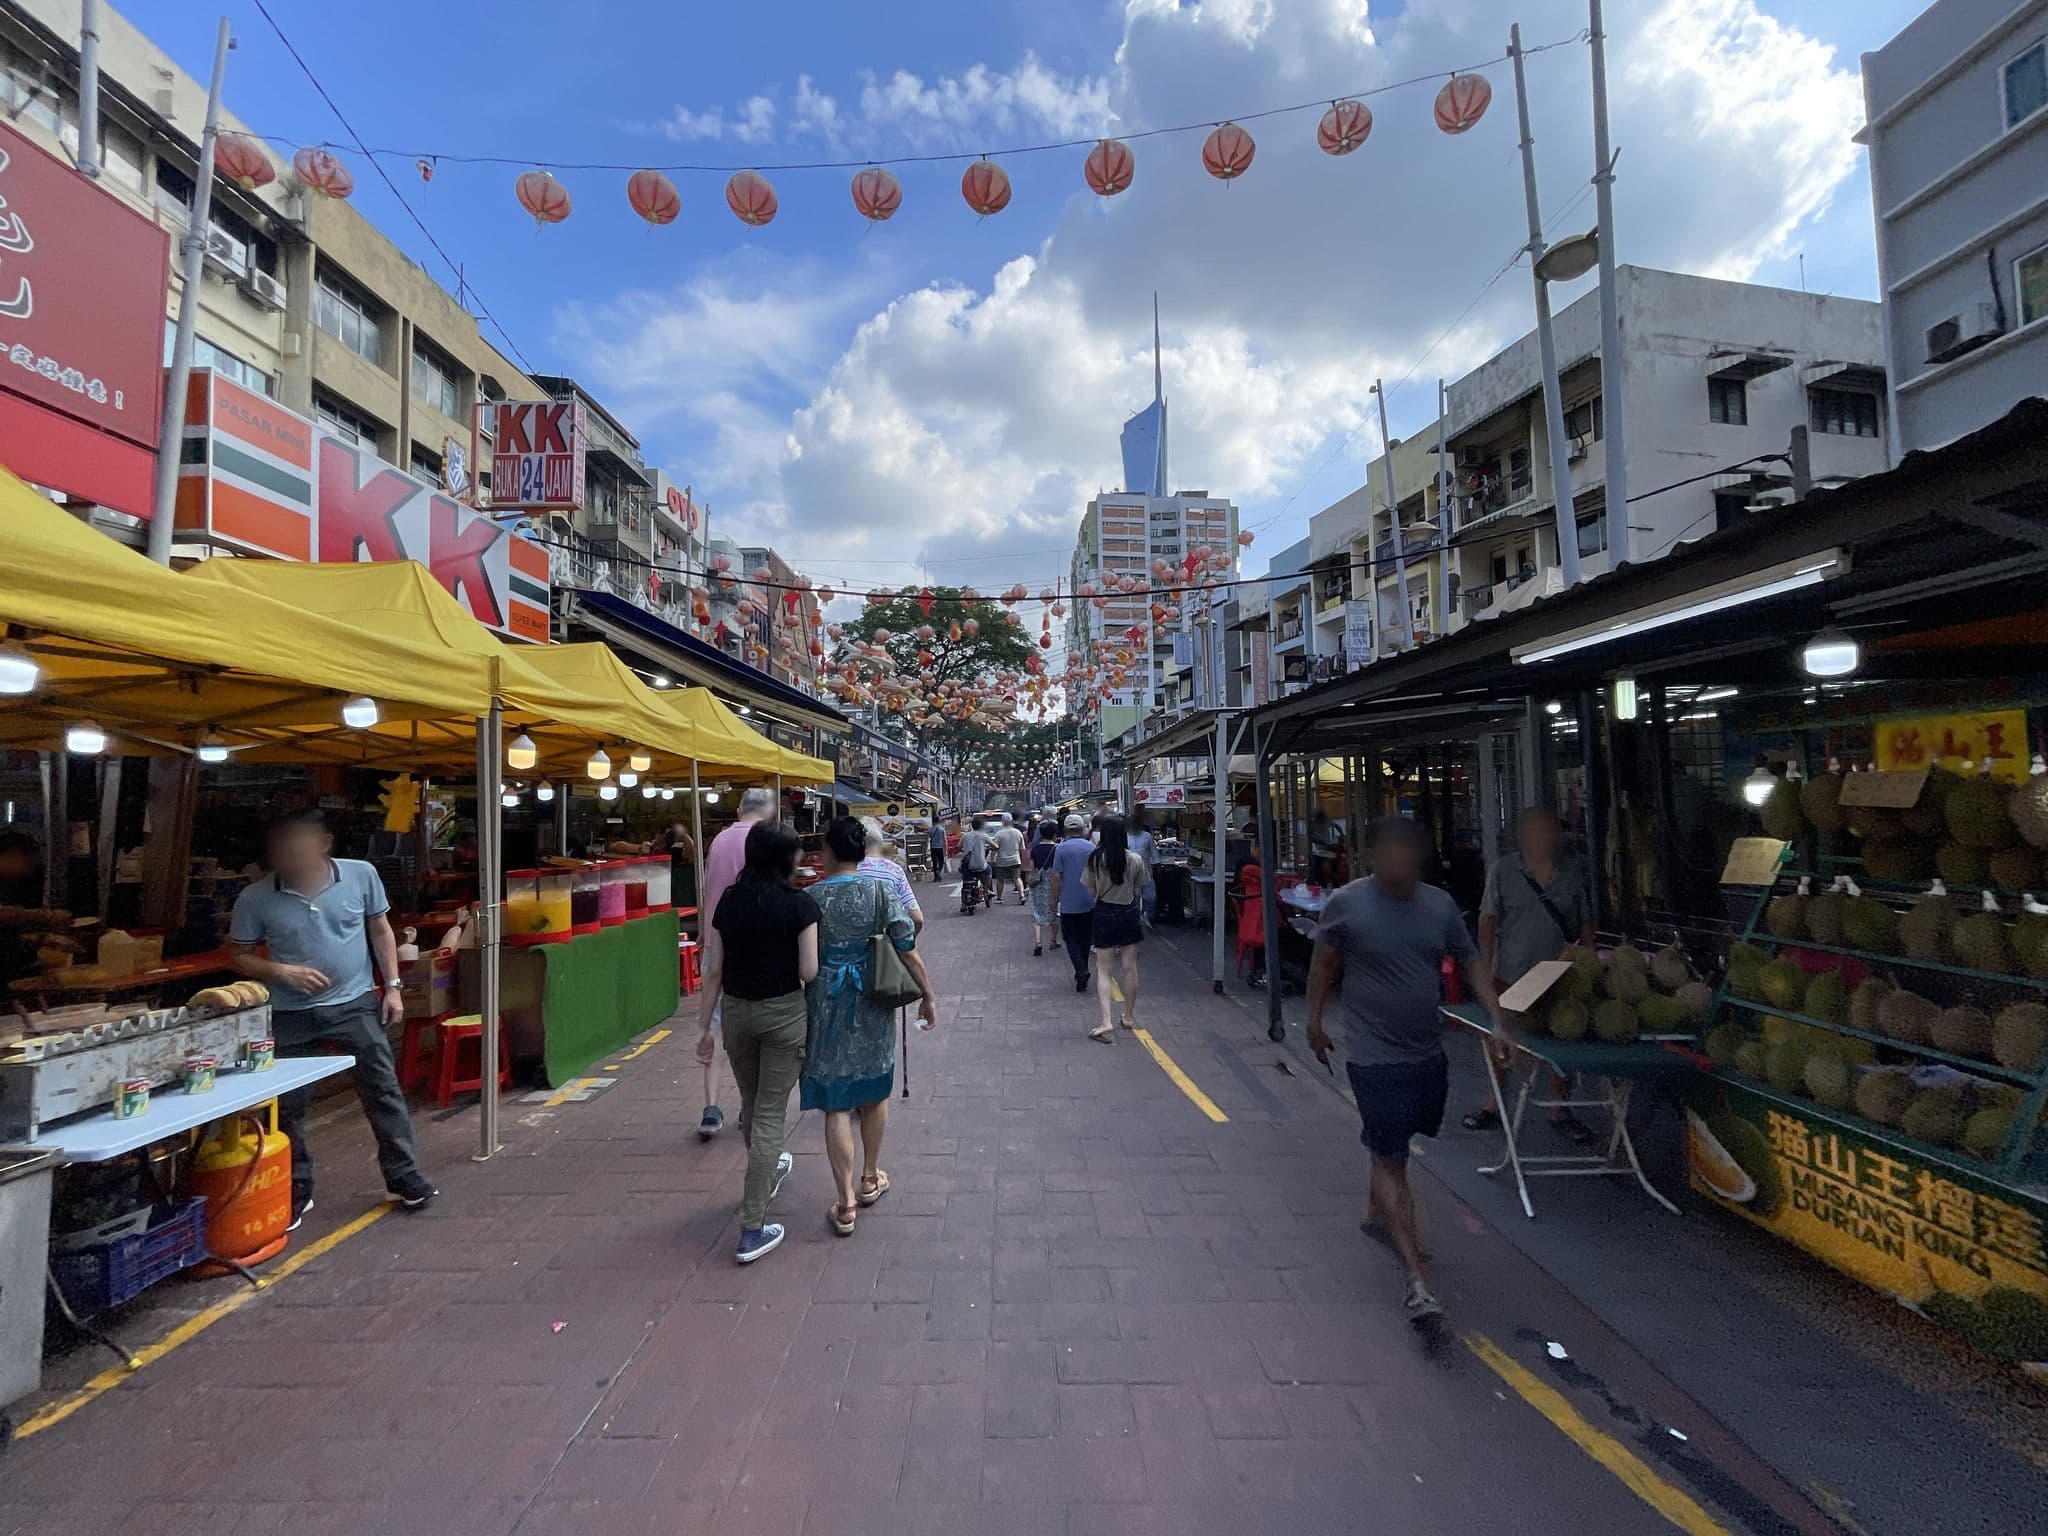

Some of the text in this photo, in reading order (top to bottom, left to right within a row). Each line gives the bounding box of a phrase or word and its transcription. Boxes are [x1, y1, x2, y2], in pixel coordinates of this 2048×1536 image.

[219, 398, 271, 435] PASAR
[498, 404, 569, 453] KK
[495, 455, 519, 498] BUKA
[521, 456, 544, 501] 24
[545, 459, 573, 498] JAM
[1791, 1166, 1992, 1281] MUSANG KING
[1792, 1188, 1905, 1261] DURIAN
